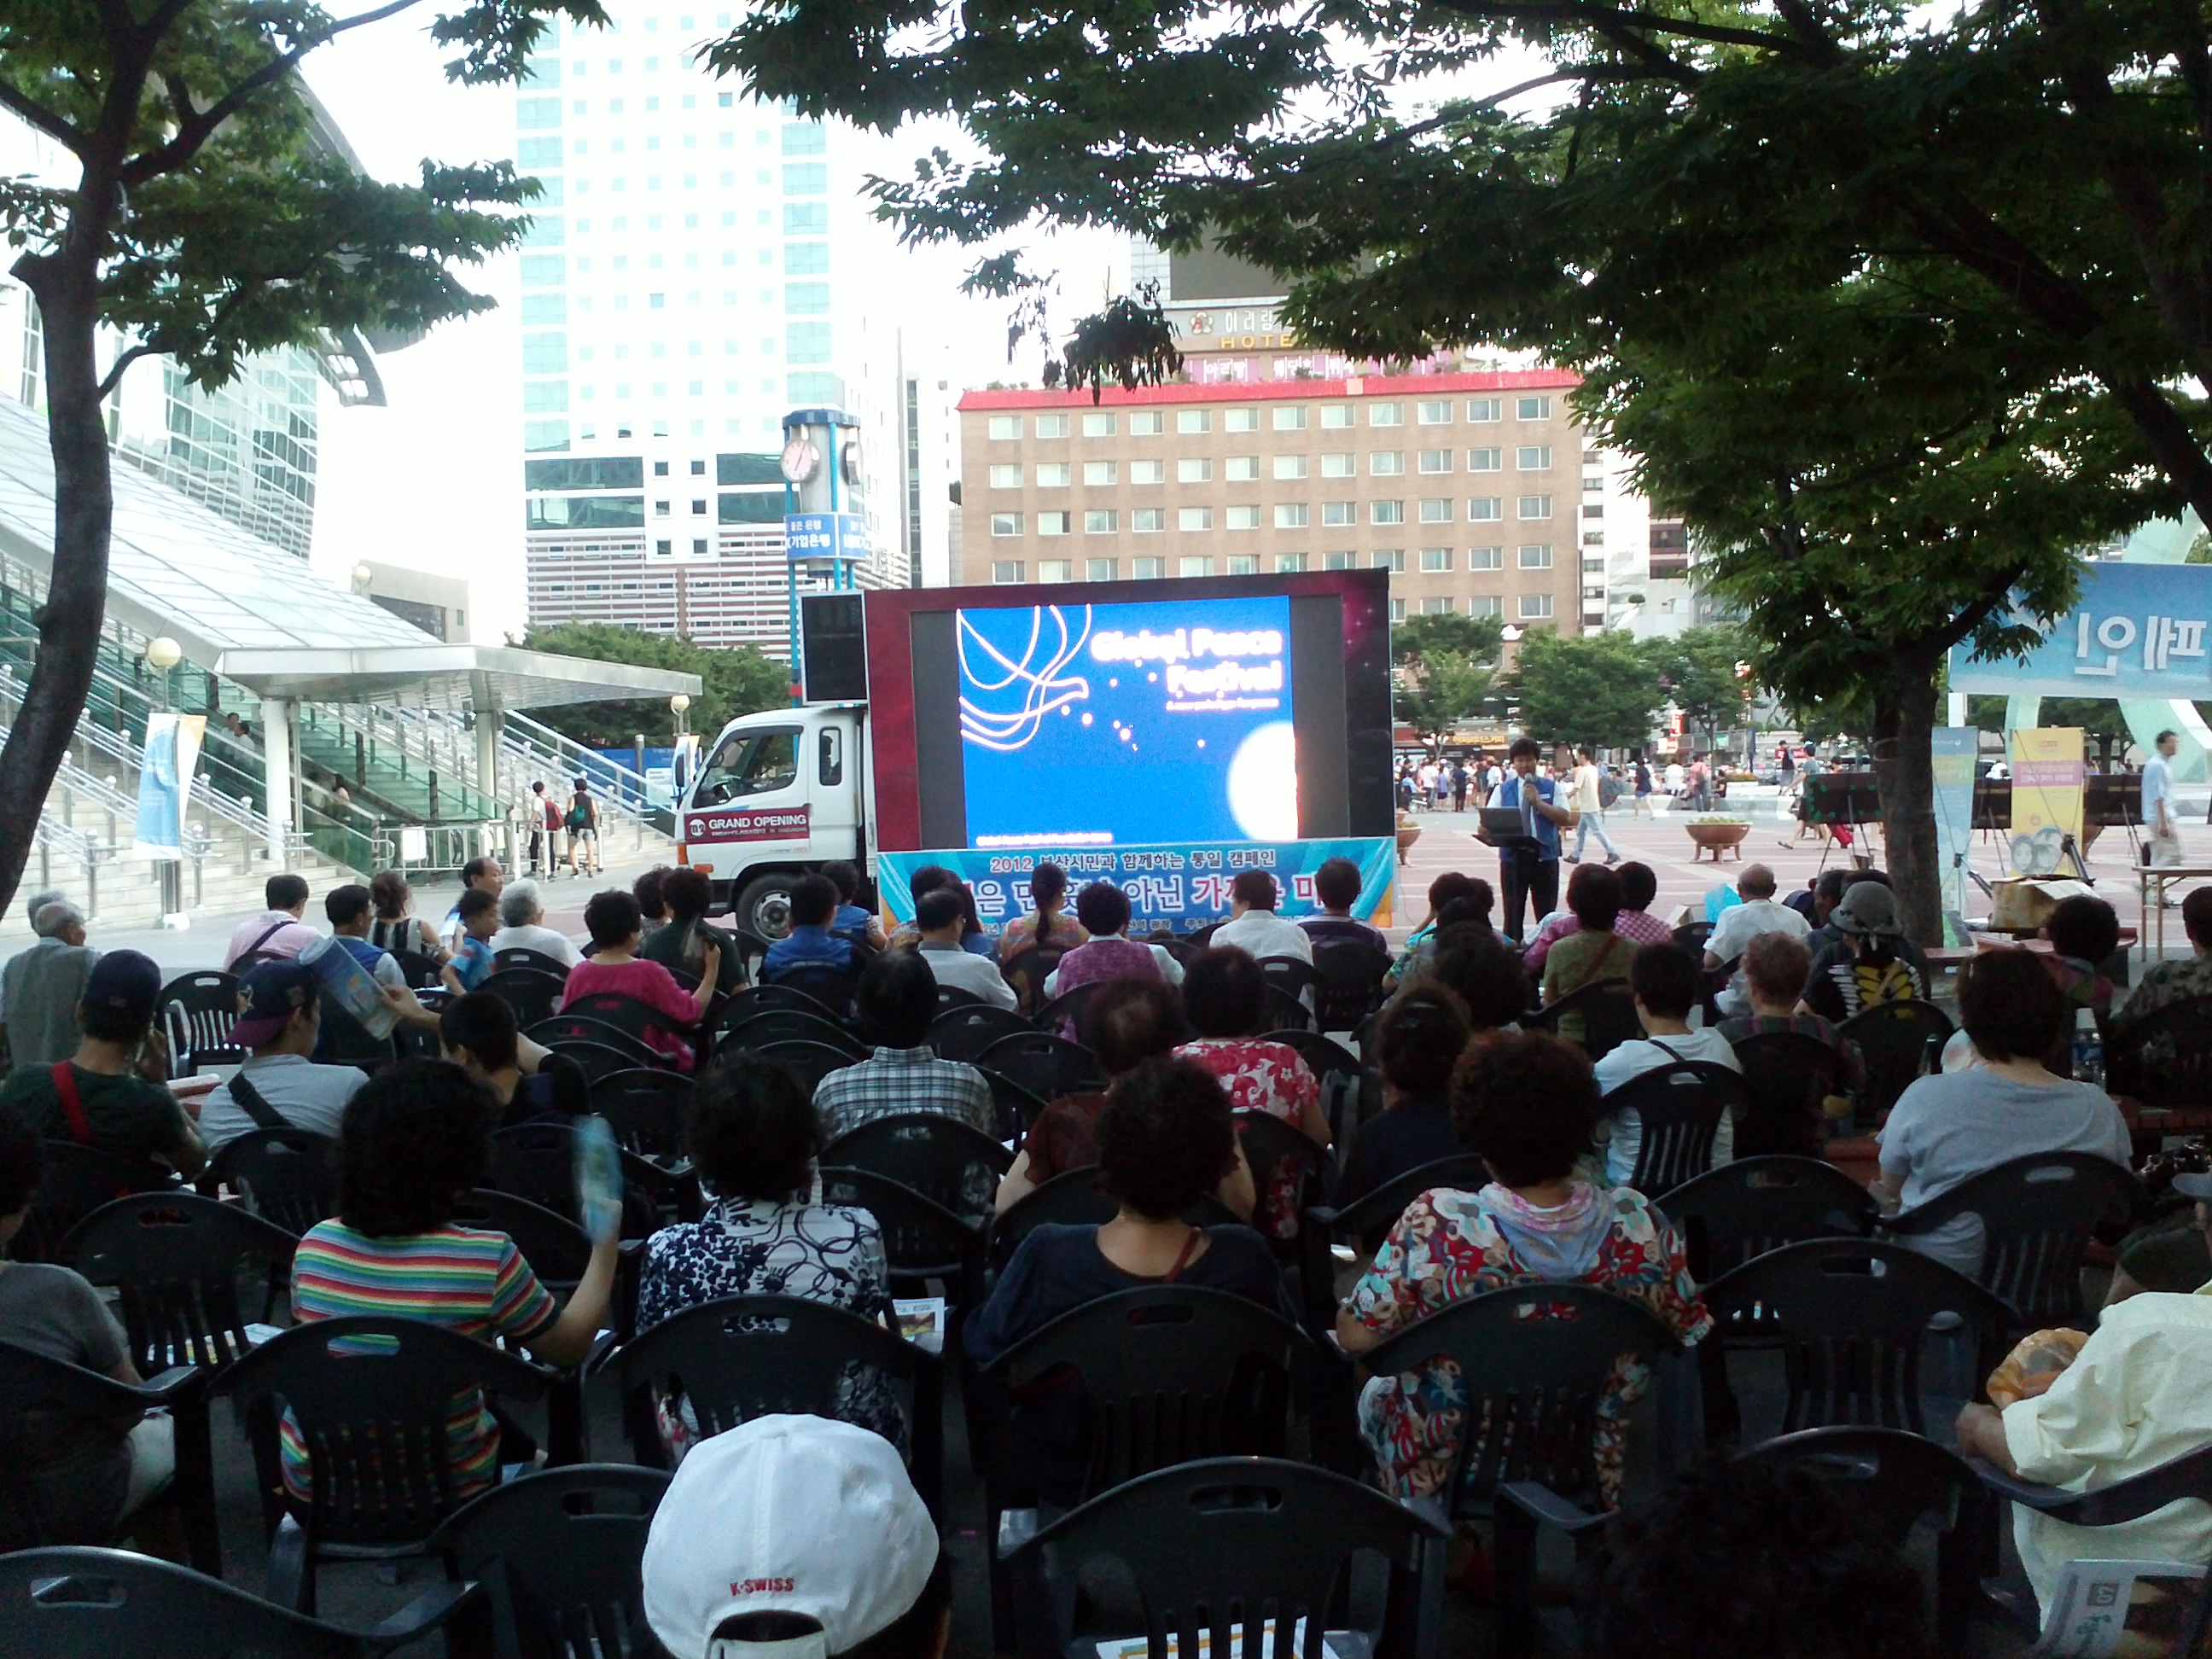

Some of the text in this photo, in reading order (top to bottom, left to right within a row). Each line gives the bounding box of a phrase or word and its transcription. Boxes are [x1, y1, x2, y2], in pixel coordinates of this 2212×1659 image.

[1220, 333, 1295, 349] HOTE
[707, 817, 751, 830] GRAND
[753, 814, 807, 828] OPENING
[990, 856, 1034, 873] 2012
[1121, 852, 1185, 871] 함께하는
[1190, 850, 1224, 869] 통일
[1226, 849, 1276, 869] 캠페인
